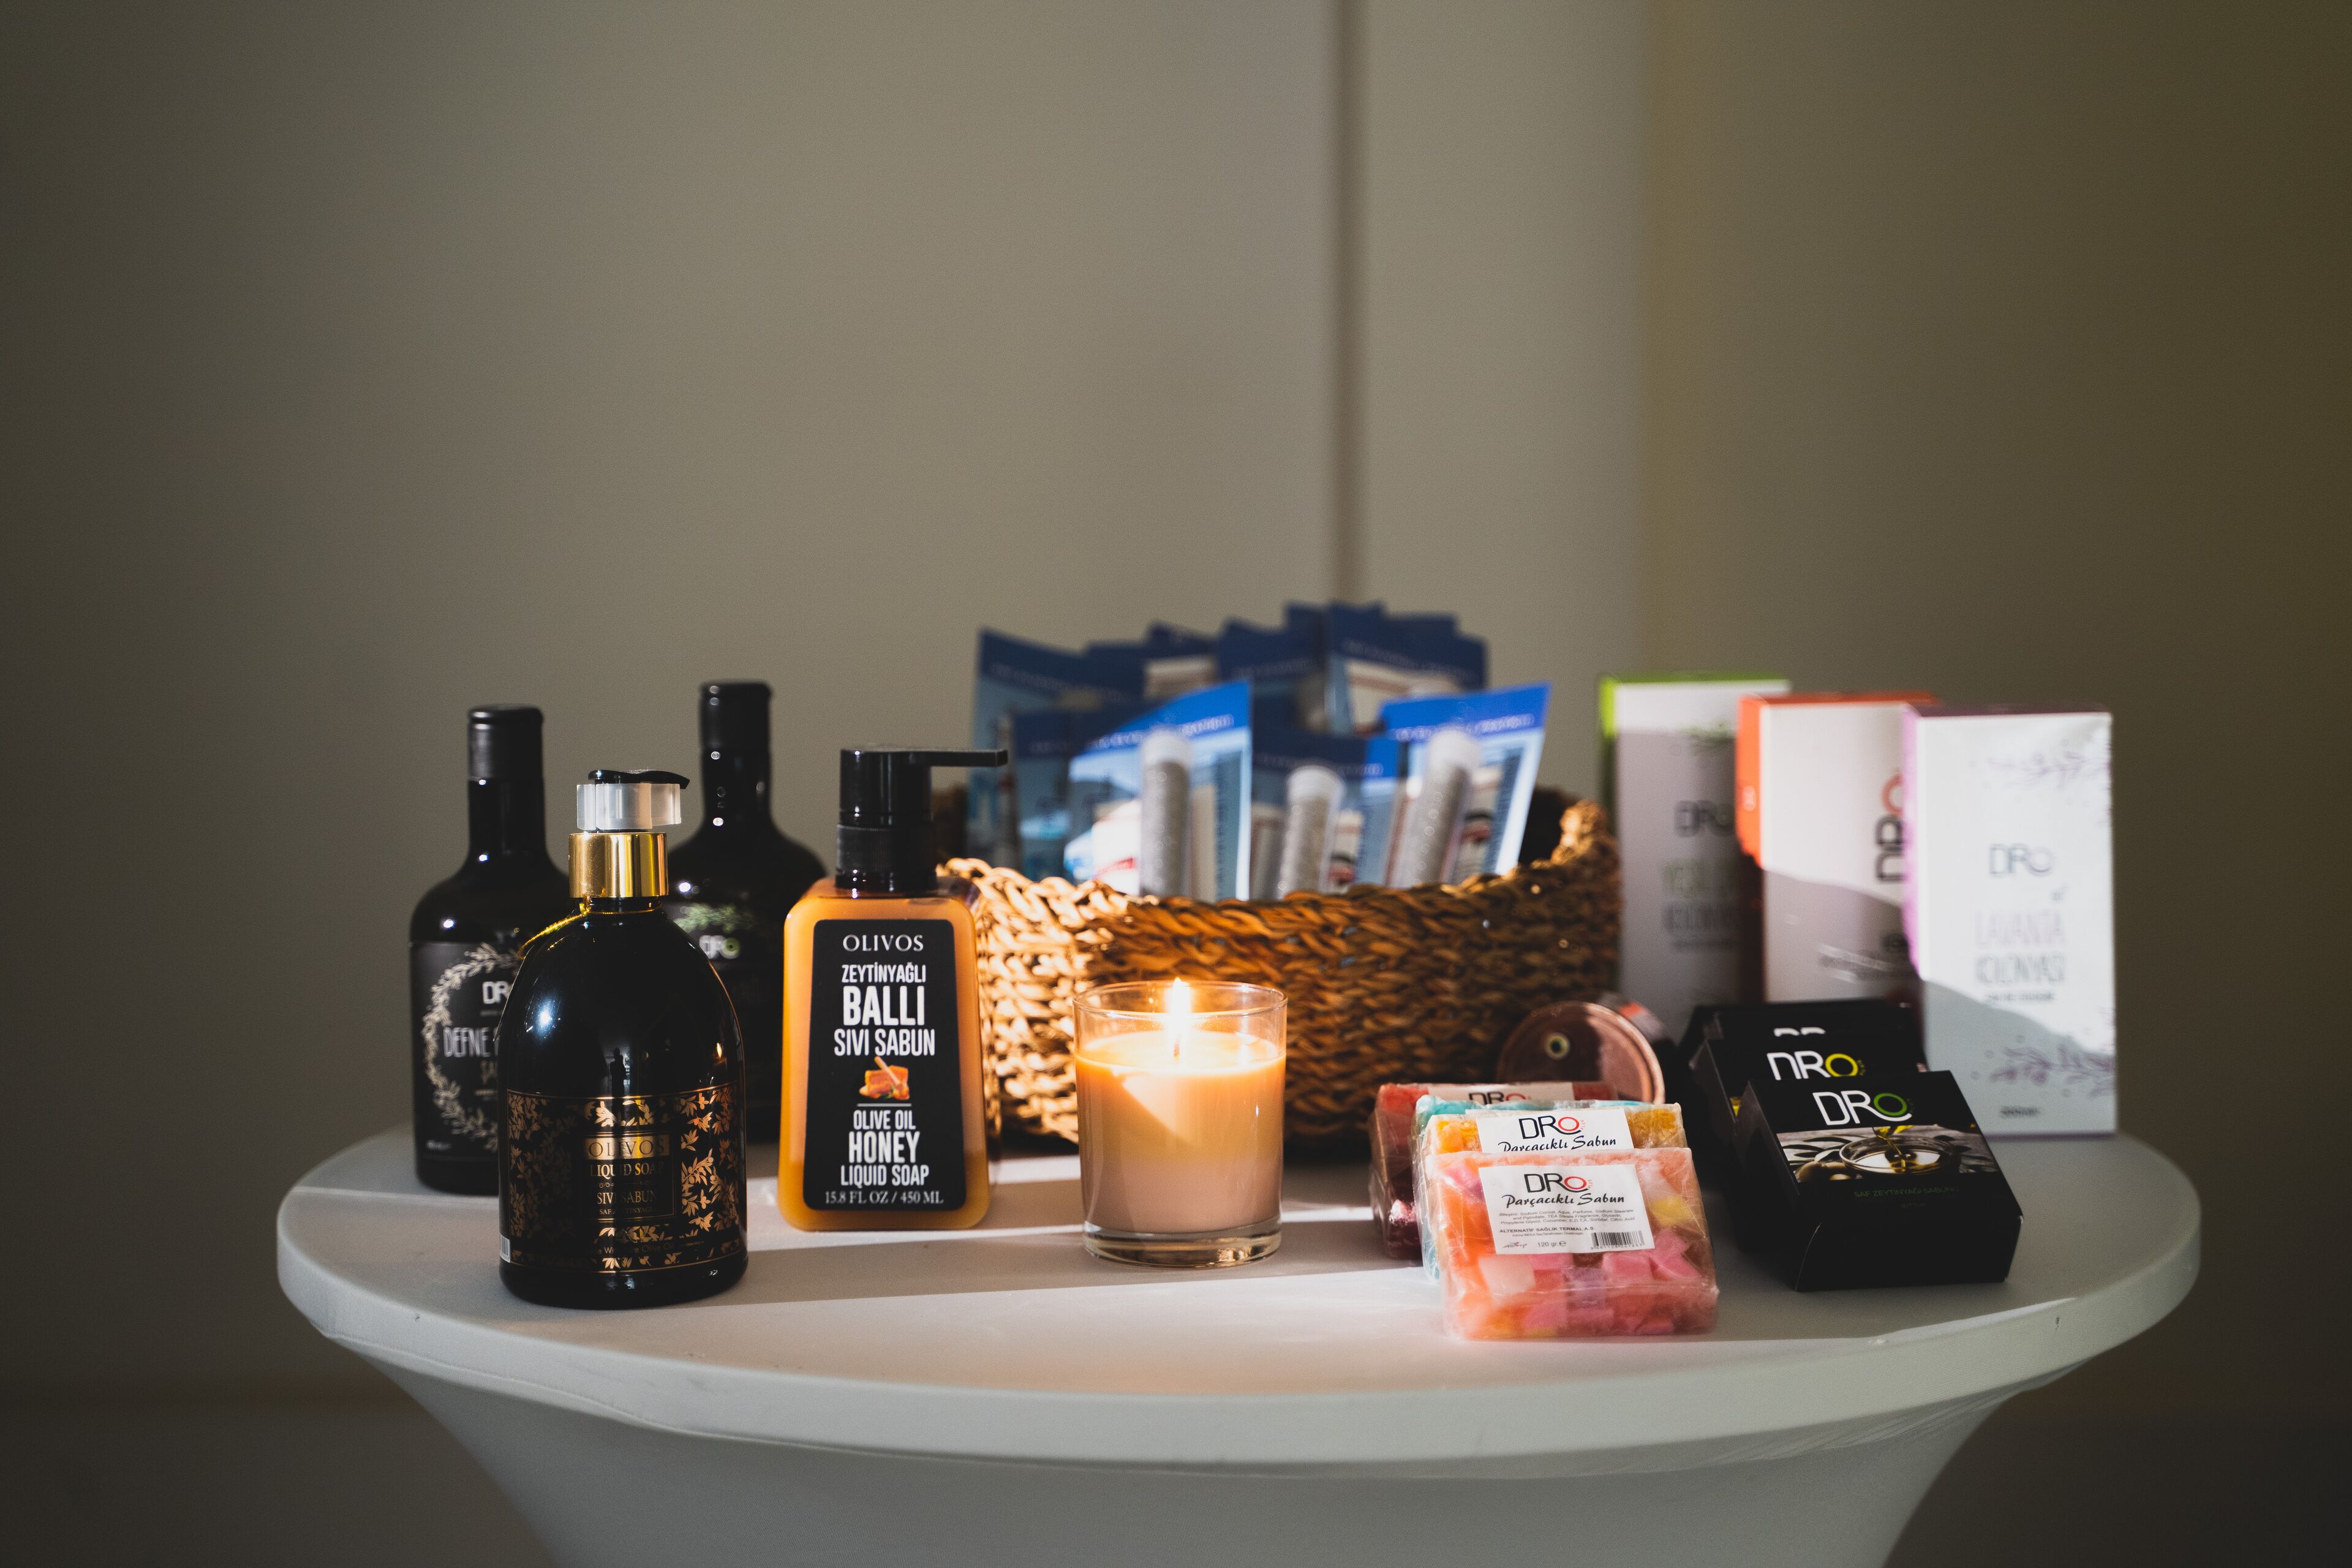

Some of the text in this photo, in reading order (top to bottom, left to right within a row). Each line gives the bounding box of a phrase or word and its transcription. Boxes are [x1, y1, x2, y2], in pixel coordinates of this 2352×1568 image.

[1989, 843, 2056, 876] DRO
[842, 934, 924, 952] OLIVOS
[841, 962, 926, 983] ZEYTİNYAĞLI
[482, 981, 514, 1005] DR
[843, 986, 925, 1026] BALLI
[443, 1027, 491, 1058] DEFNE
[834, 1029, 935, 1056] SIVI SABUN
[853, 1109, 916, 1130] OLIVE OIL
[1812, 1090, 1912, 1125] DRO
[1518, 1115, 1581, 1139] DRO
[589, 1139, 665, 1157] OLIVOS
[848, 1131, 920, 1164] HONEY
[1571, 1135, 1616, 1150] Sabun
[840, 1164, 930, 1188] LIQUID SOAP
[1523, 1173, 1589, 1193] DRO
[824, 1191, 846, 1204] 15.8
[848, 1191, 867, 1204] FL
[870, 1191, 889, 1204] OZ
[900, 1191, 921, 1204] 450
[923, 1191, 944, 1205] ML
[1502, 1192, 1624, 1208] Parçacıklı Sabun
